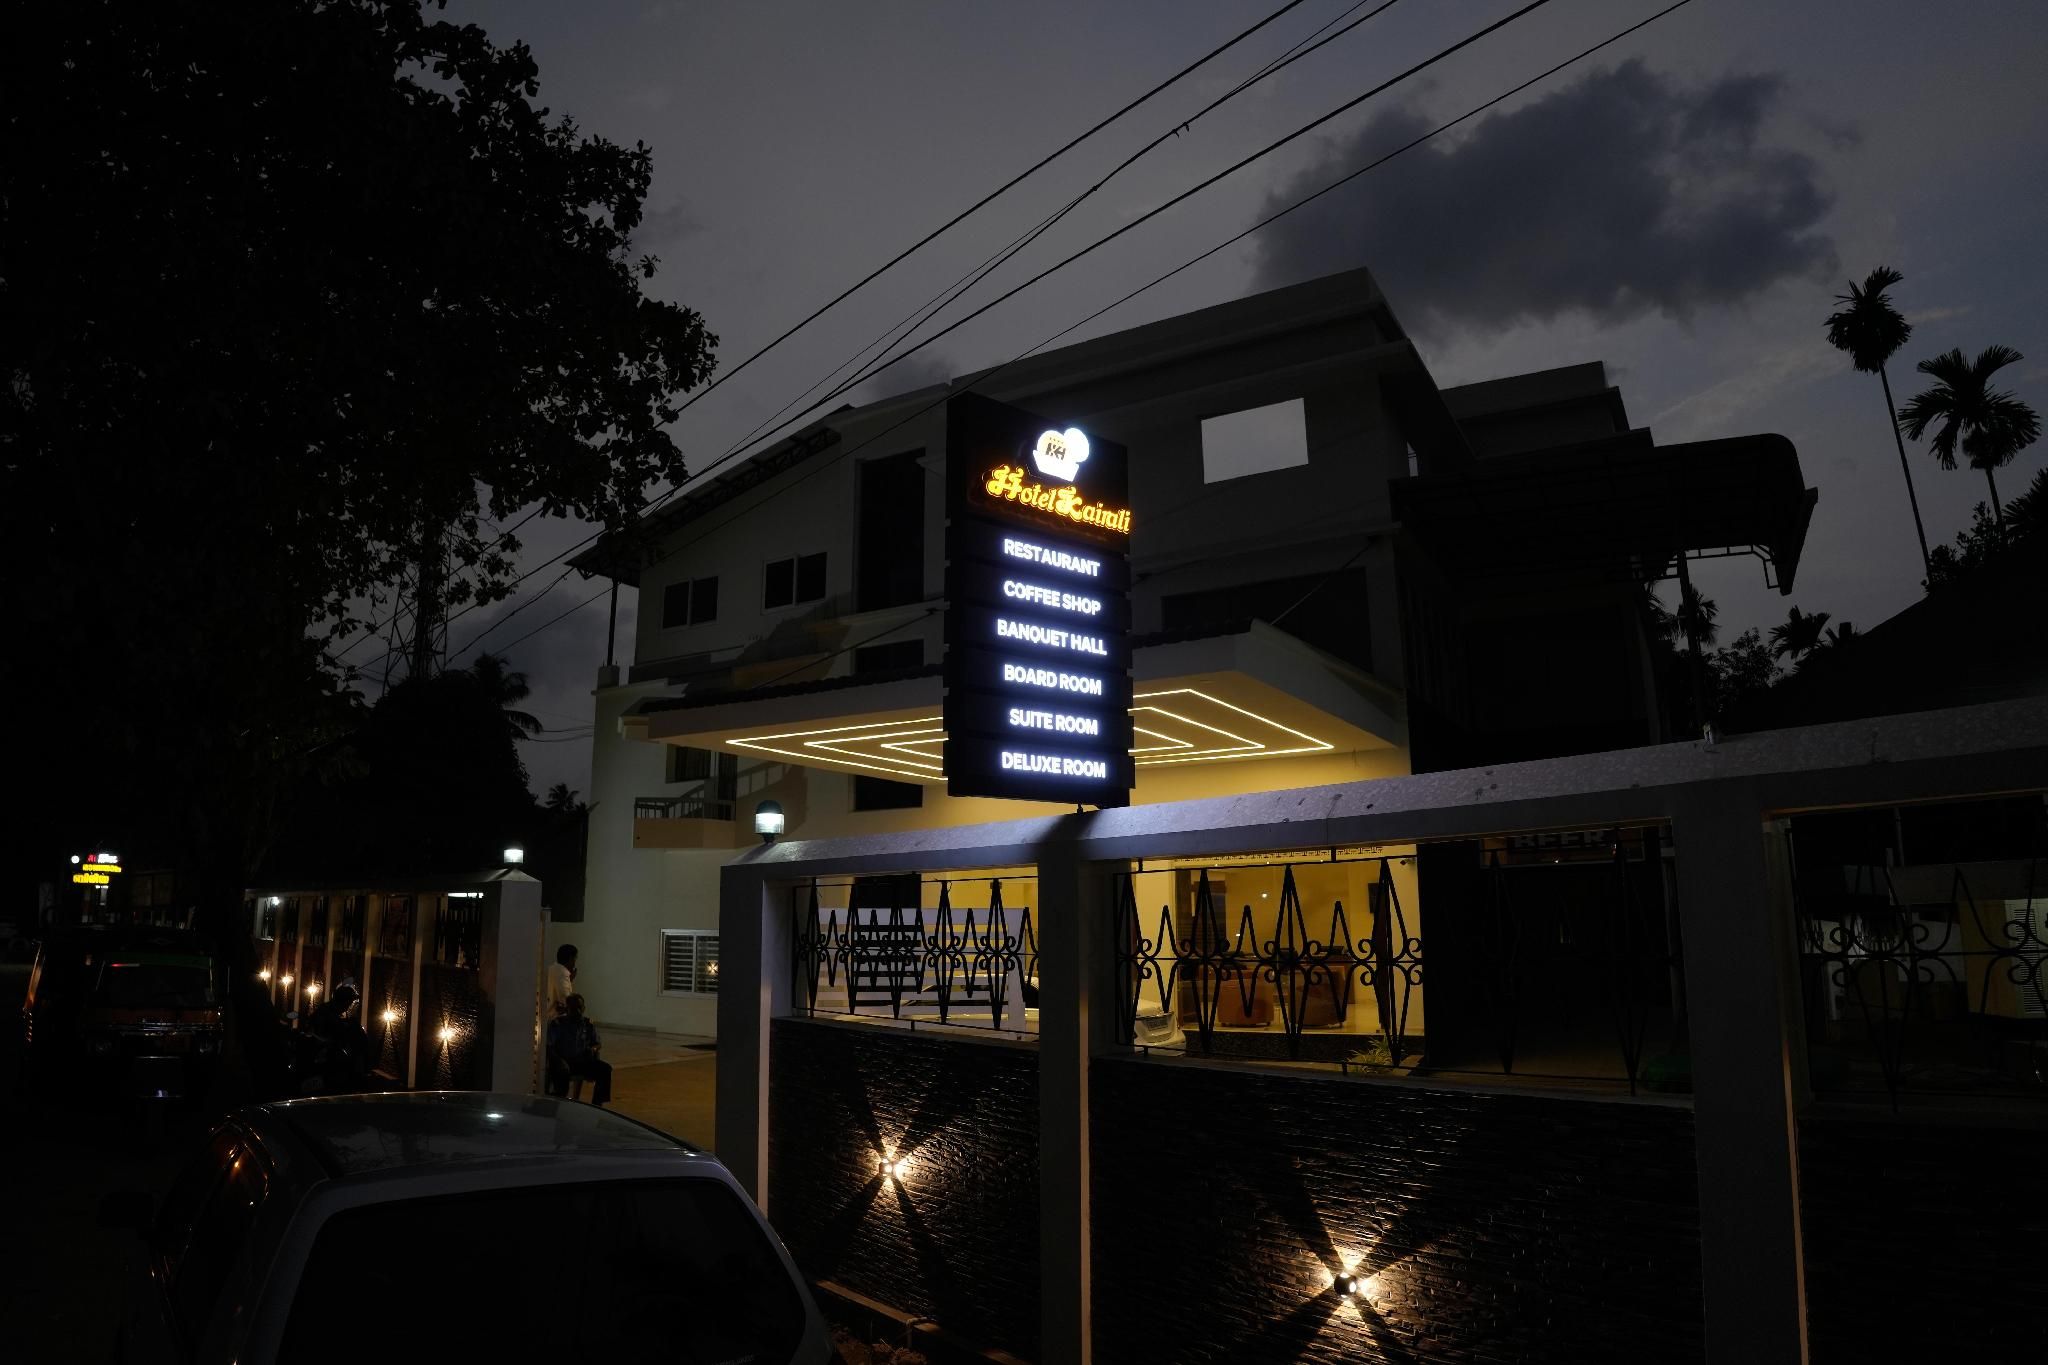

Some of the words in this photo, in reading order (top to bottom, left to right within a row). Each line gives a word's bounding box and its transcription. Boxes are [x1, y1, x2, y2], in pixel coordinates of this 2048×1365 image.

[985, 465, 1056, 512] Hotel
[1055, 487, 1132, 535] Kairali
[1004, 538, 1101, 577] RESTAURANT
[1003, 580, 1061, 608] COFFEE
[1062, 594, 1102, 616] SHOP
[997, 618, 1069, 648] BANQUET
[1070, 633, 1108, 656] HALL
[1004, 664, 1058, 688] BOARD
[1059, 673, 1102, 696] ROOM
[1009, 708, 1054, 730] SUITE
[1055, 714, 1098, 736] ROOM
[1001, 751, 1062, 774] DELUXE
[1063, 758, 1106, 779] ROOM
